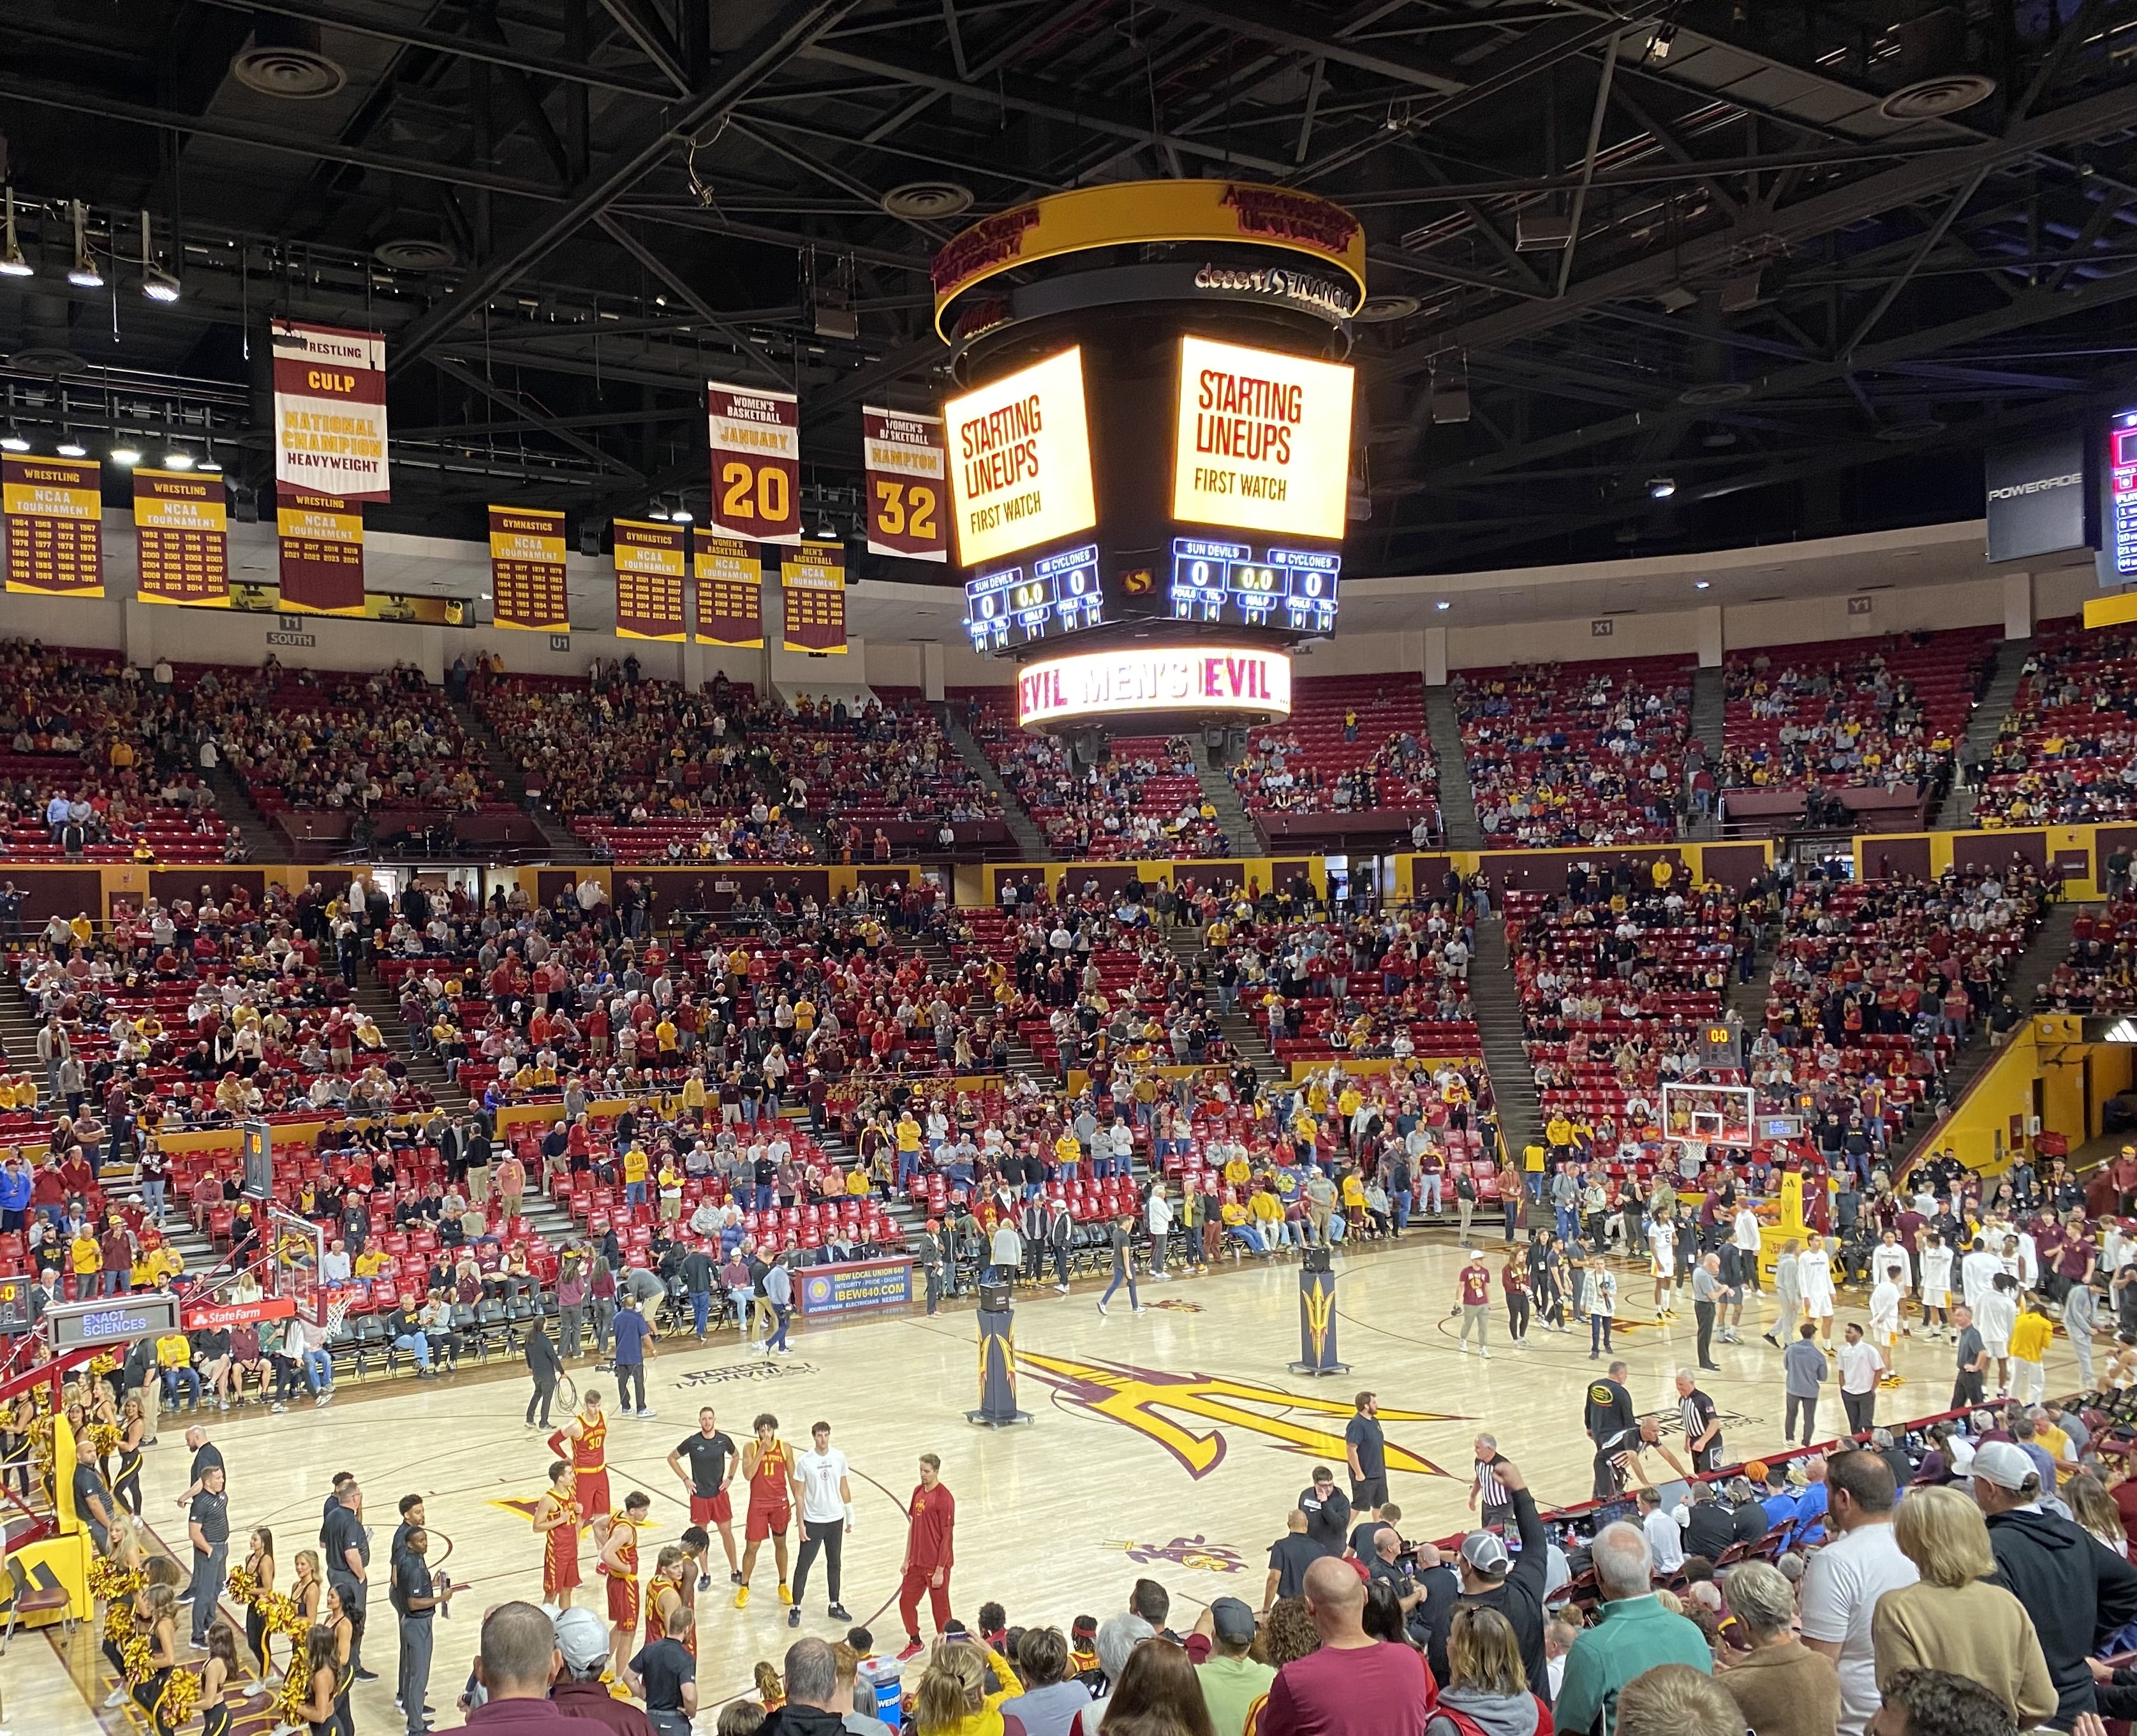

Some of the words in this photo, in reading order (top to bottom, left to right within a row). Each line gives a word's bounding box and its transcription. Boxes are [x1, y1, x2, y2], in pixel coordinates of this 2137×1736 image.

[300, 342, 362, 358] RESTLING
[308, 371, 355, 392] CULP
[1199, 369, 1302, 423] STARTING
[733, 395, 774, 412] WOMEN'S
[727, 406, 781, 423] BASKETBALL
[285, 411, 377, 438] NATIONAL
[885, 419, 924, 433] WOMEN'S
[961, 395, 1042, 460] STARTING
[282, 431, 382, 458] CHAMPION
[721, 427, 788, 450] JANUARY
[1197, 413, 1290, 464] LINEUPS
[288, 453, 378, 473] HEAVYWEIGHT
[873, 448, 937, 470] HAMPTON
[24, 469, 80, 483] WRESTLING
[965, 439, 1038, 500] LINEUPS
[154, 483, 206, 496] WRESTLING
[1195, 467, 1236, 494] FIRST
[1241, 473, 1287, 501] WATCH
[1988, 472, 2083, 501] POWERADE
[35, 490, 70, 503] NCAA
[722, 462, 790, 522] 20
[17, 501, 89, 515] TOURNAMENT
[296, 496, 344, 508] WRESTLING
[164, 503, 197, 516] NCAA
[876, 481, 936, 539] 32
[970, 503, 1000, 534] FIRST
[1003, 490, 1042, 523] WATCH
[147, 515, 215, 528] TOURNAMENT
[306, 515, 337, 528] NCAA
[503, 519, 553, 531] GYMNASTICS
[289, 526, 353, 540] TOURNAMENT
[626, 532, 672, 544] GYMNASTICS
[515, 538, 542, 550] NCAA
[712, 538, 743, 548] WOMEN'S
[501, 548, 558, 561] TOURNAMENT
[637, 550, 663, 562] NCAA
[707, 545, 748, 557] BASKETBALL
[803, 547, 823, 556] MEN'S
[1187, 543, 1205, 554] SUN
[1208, 545, 1239, 559] DEVILS
[343, 556, 359, 564] 2024
[624, 560, 676, 573] TOURNAMENT
[716, 559, 740, 570] NCAA
[794, 555, 832, 565] BASKETBALL
[1053, 550, 1090, 571] CYCLONES
[1289, 554, 1333, 568] CYCLONES
[703, 569, 753, 580] TOURNAMENT
[802, 568, 825, 578] NCAA
[1192, 561, 1209, 586] 0
[1243, 567, 1273, 590] 0.0
[790, 578, 837, 588] TOURNAMENT
[975, 581, 989, 592] SUN
[990, 573, 1014, 589] DEVILS
[1070, 570, 1084, 594] 0
[1306, 573, 1322, 597] 0
[1019, 583, 1043, 607] 0.0
[982, 595, 994, 619] 0
[1851, 600, 1868, 611] Y1
[285, 617, 299, 629] T1
[1595, 622, 1610, 634] X1
[270, 634, 312, 645] SOUTH
[552, 638, 568, 649] U1
[834, 1273, 852, 1282] IBEW
[852, 1270, 871, 1279] LOCAL
[873, 1268, 892, 1276] UNION
[835, 1280, 862, 1290] INTEGRITY
[865, 1277, 880, 1286] PRIDE
[835, 1283, 905, 1302] IBEW640.COM
[808, 1304, 843, 1313] JOURNEYMAN
[846, 1298, 879, 1307] ELECTRICIANS
[82, 1310, 125, 1325] EXACT
[83, 1318, 147, 1337] SCIENCES
[588, 1436, 602, 1450] 30
[764, 1463, 774, 1476] 11
